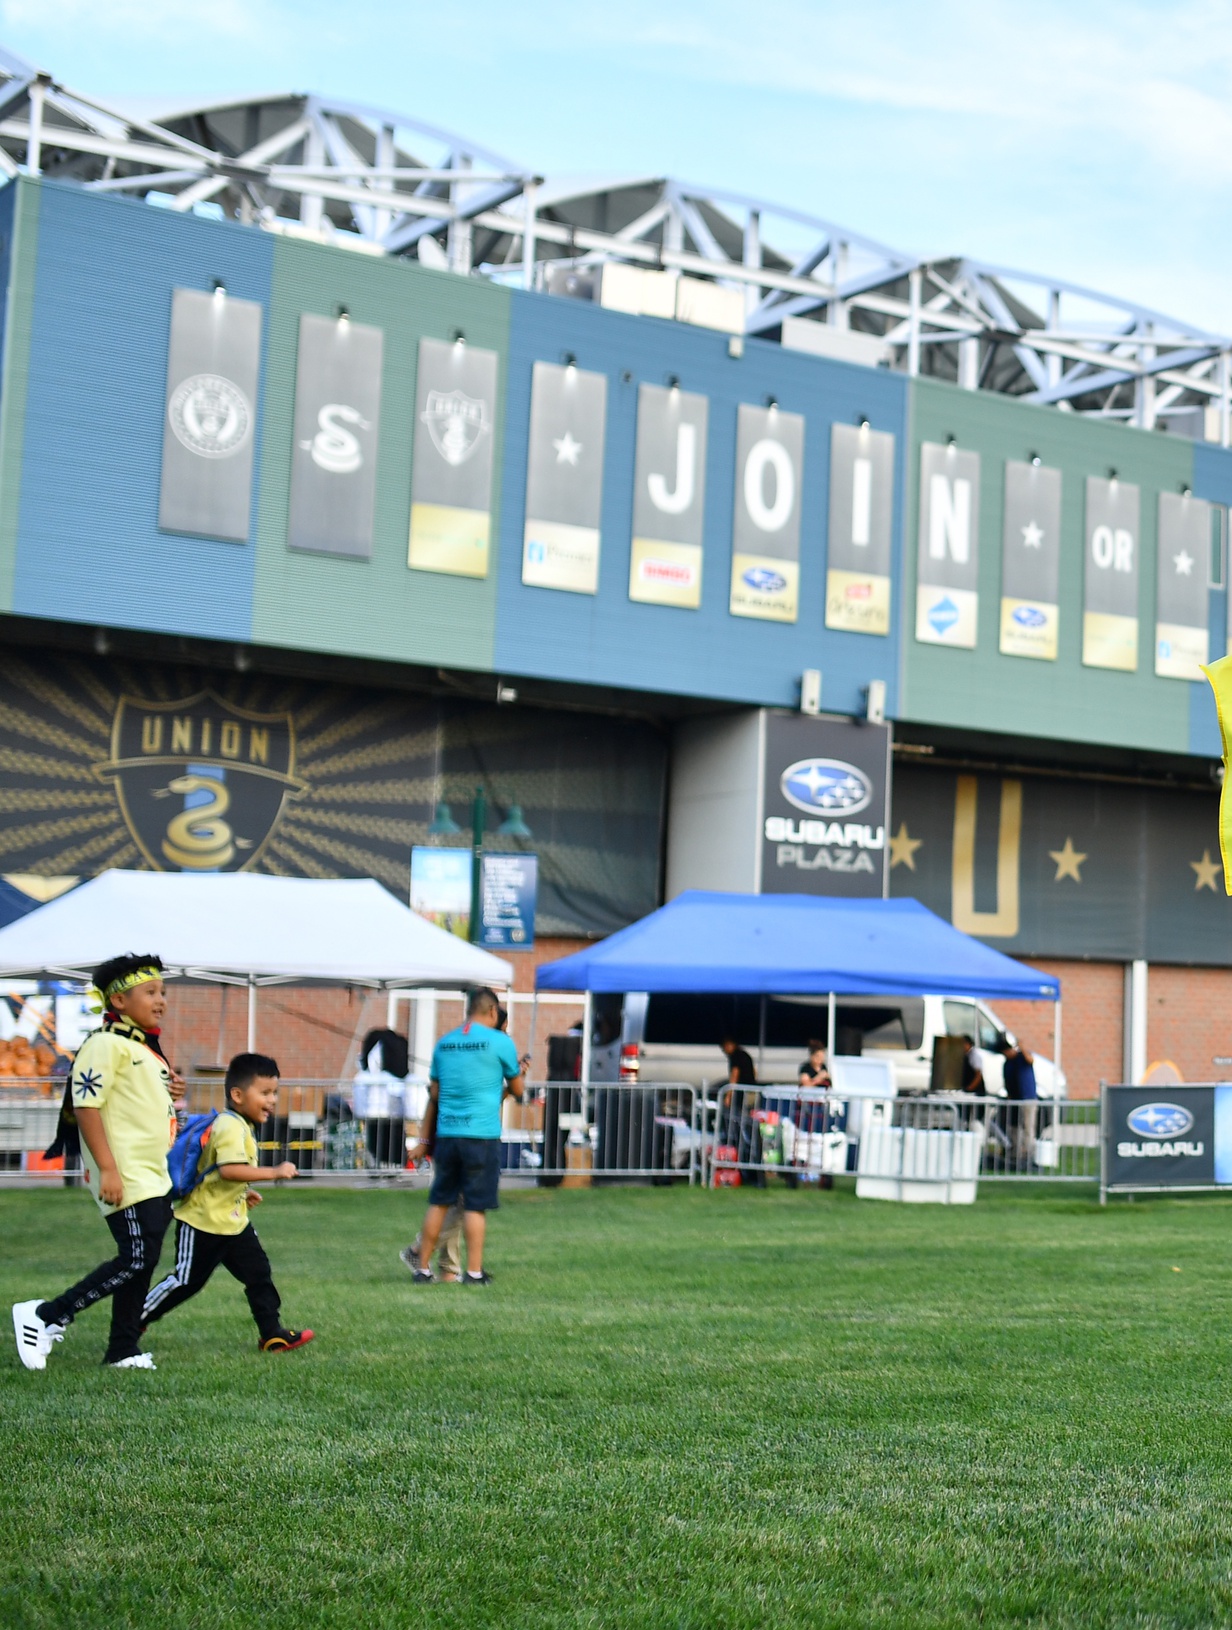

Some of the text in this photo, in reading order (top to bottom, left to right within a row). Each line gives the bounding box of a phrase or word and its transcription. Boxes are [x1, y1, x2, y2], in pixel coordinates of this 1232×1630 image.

[1092, 525, 1133, 574] OR
[142, 715, 272, 764] UNION
[765, 816, 885, 850] SUBARU
[777, 847, 875, 874] PLAZA
[1117, 1141, 1204, 1157] SUBARU
